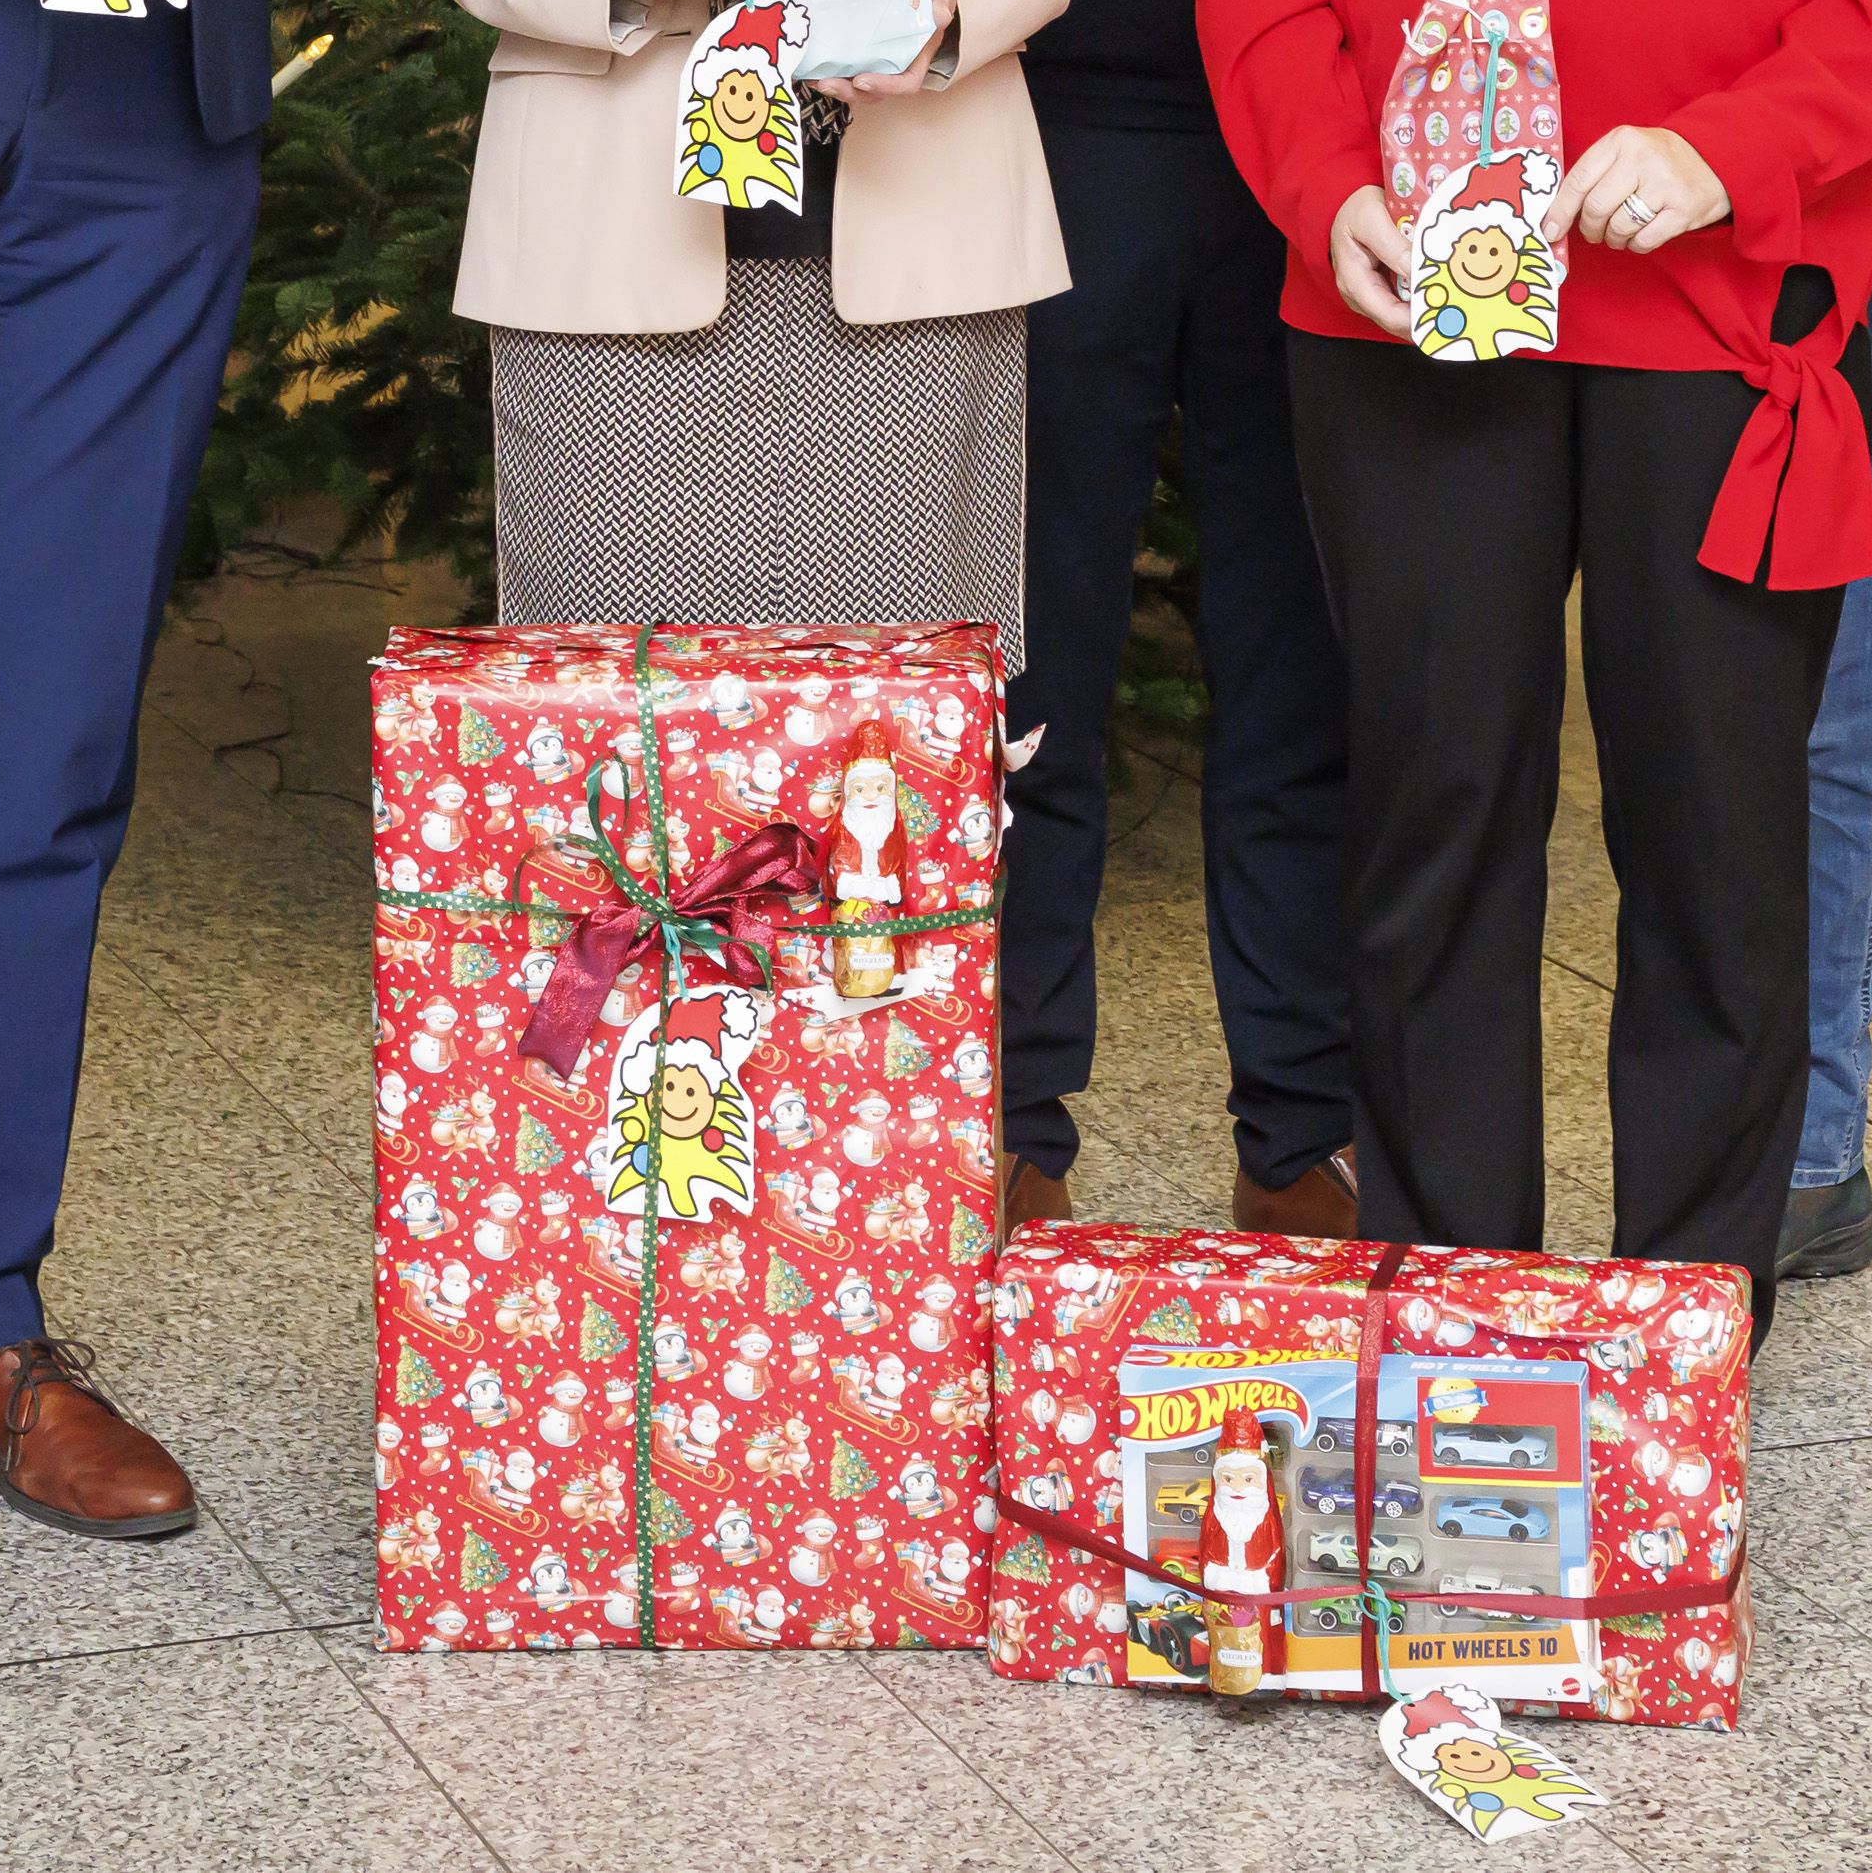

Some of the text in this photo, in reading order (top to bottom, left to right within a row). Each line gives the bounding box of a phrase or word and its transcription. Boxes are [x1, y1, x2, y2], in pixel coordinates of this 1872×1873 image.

[1408, 1637, 1559, 1661] HOT WHEELS 10
